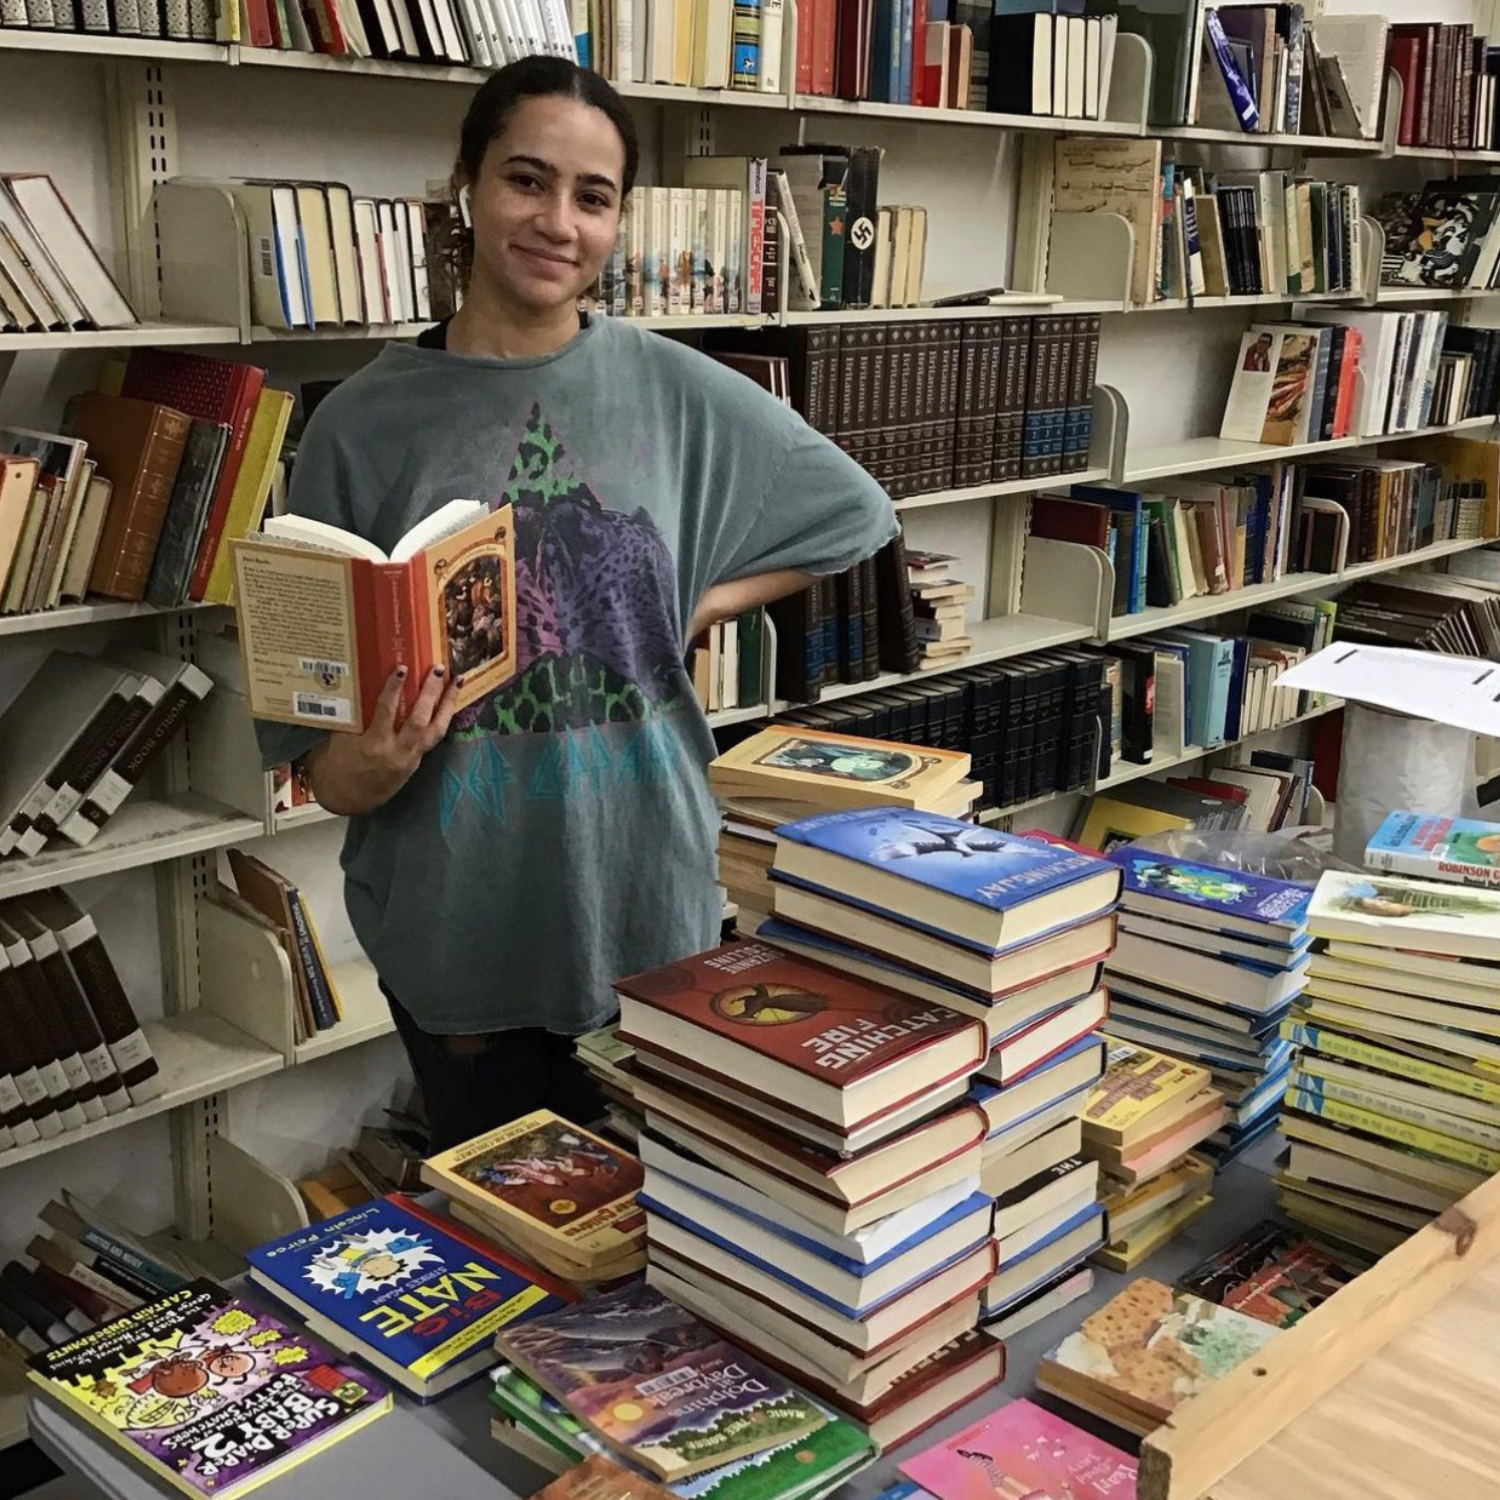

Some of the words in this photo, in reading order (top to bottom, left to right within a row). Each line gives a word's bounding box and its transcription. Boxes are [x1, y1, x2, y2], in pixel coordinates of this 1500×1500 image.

[1438, 862, 1490, 878] ROBINSON
[801, 1019, 878, 1054] FIRE
[815, 1009, 958, 1071] CATCHING
[1051, 1157, 1083, 1176] THE
[323, 1206, 381, 1233] Lincoln
[358, 1262, 502, 1339] NATE
[650, 1361, 750, 1408] Daybreak
[667, 1377, 770, 1418] Dolphins
[237, 1392, 315, 1440] BABY
[765, 1407, 807, 1422] MAGIC
[191, 1432, 238, 1459] 2
